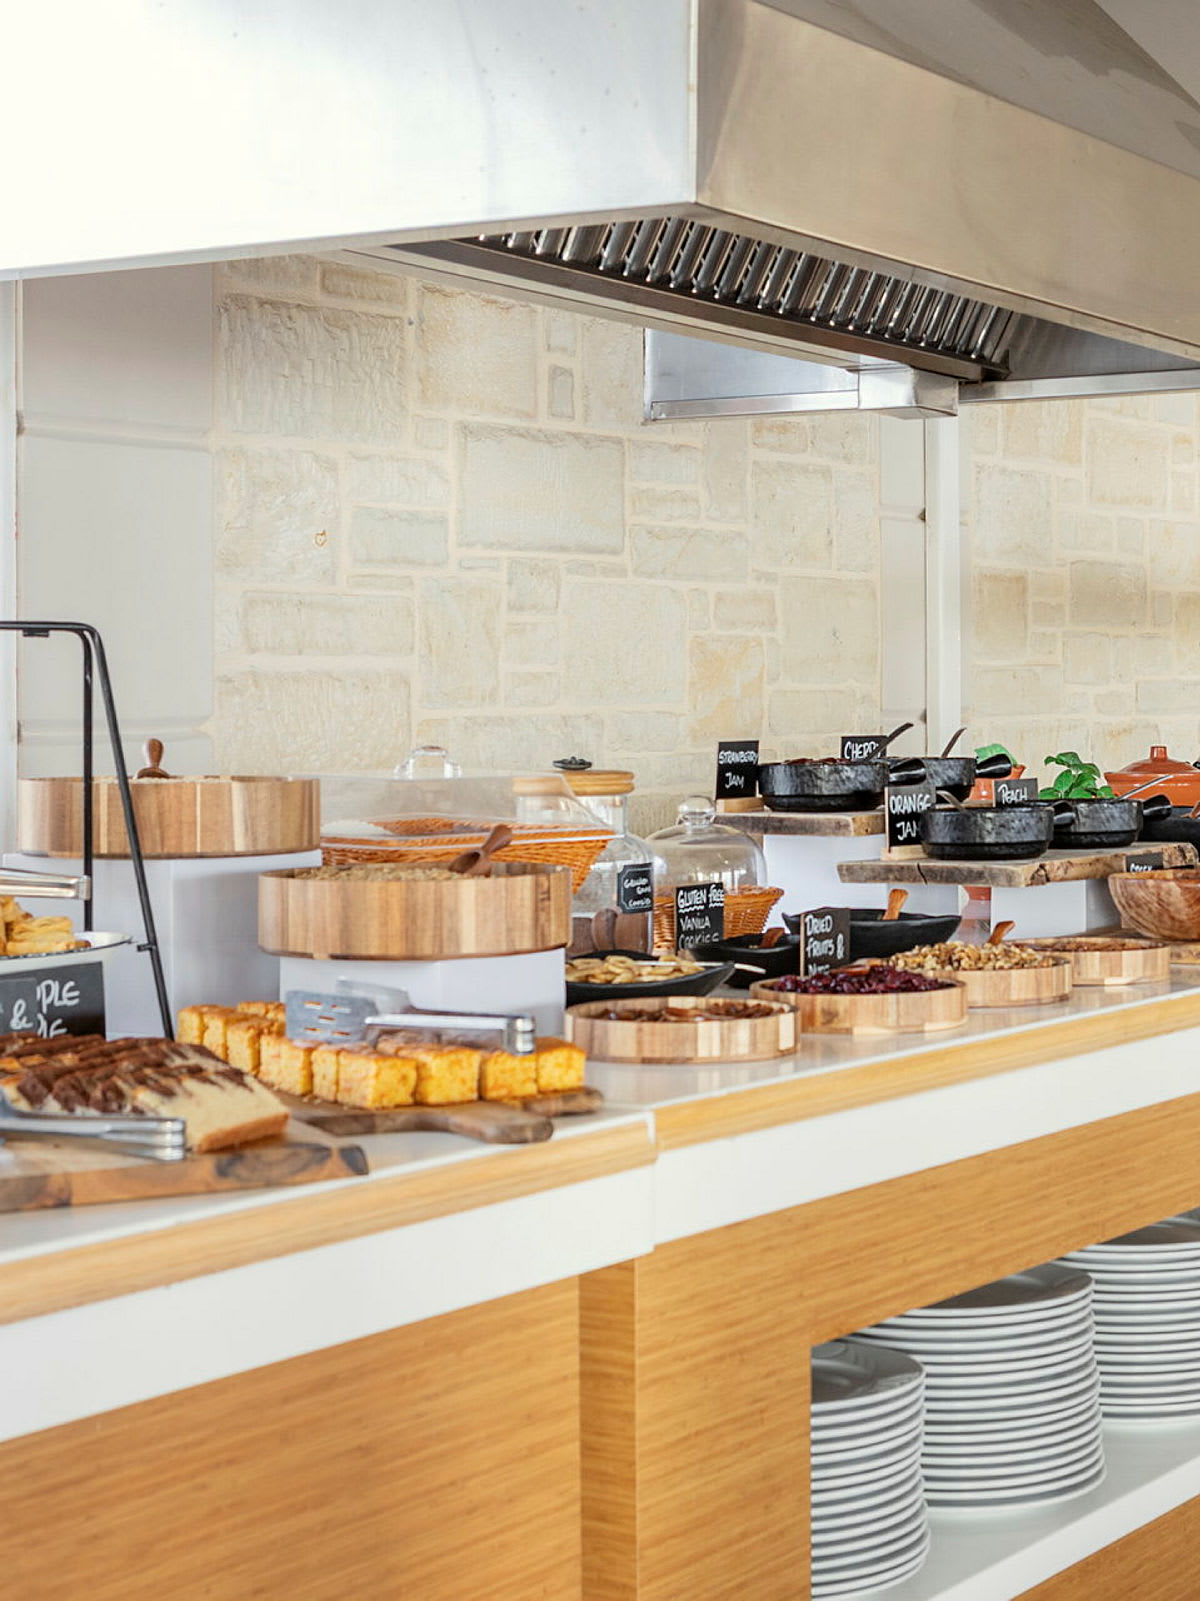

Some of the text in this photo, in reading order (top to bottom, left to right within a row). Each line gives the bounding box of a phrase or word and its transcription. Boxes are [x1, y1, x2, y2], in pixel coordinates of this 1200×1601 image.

[844, 741, 882, 761] CHERR
[725, 772, 745, 789] JAM
[36, 979, 80, 1014] PLE
[10, 998, 34, 1030] &
